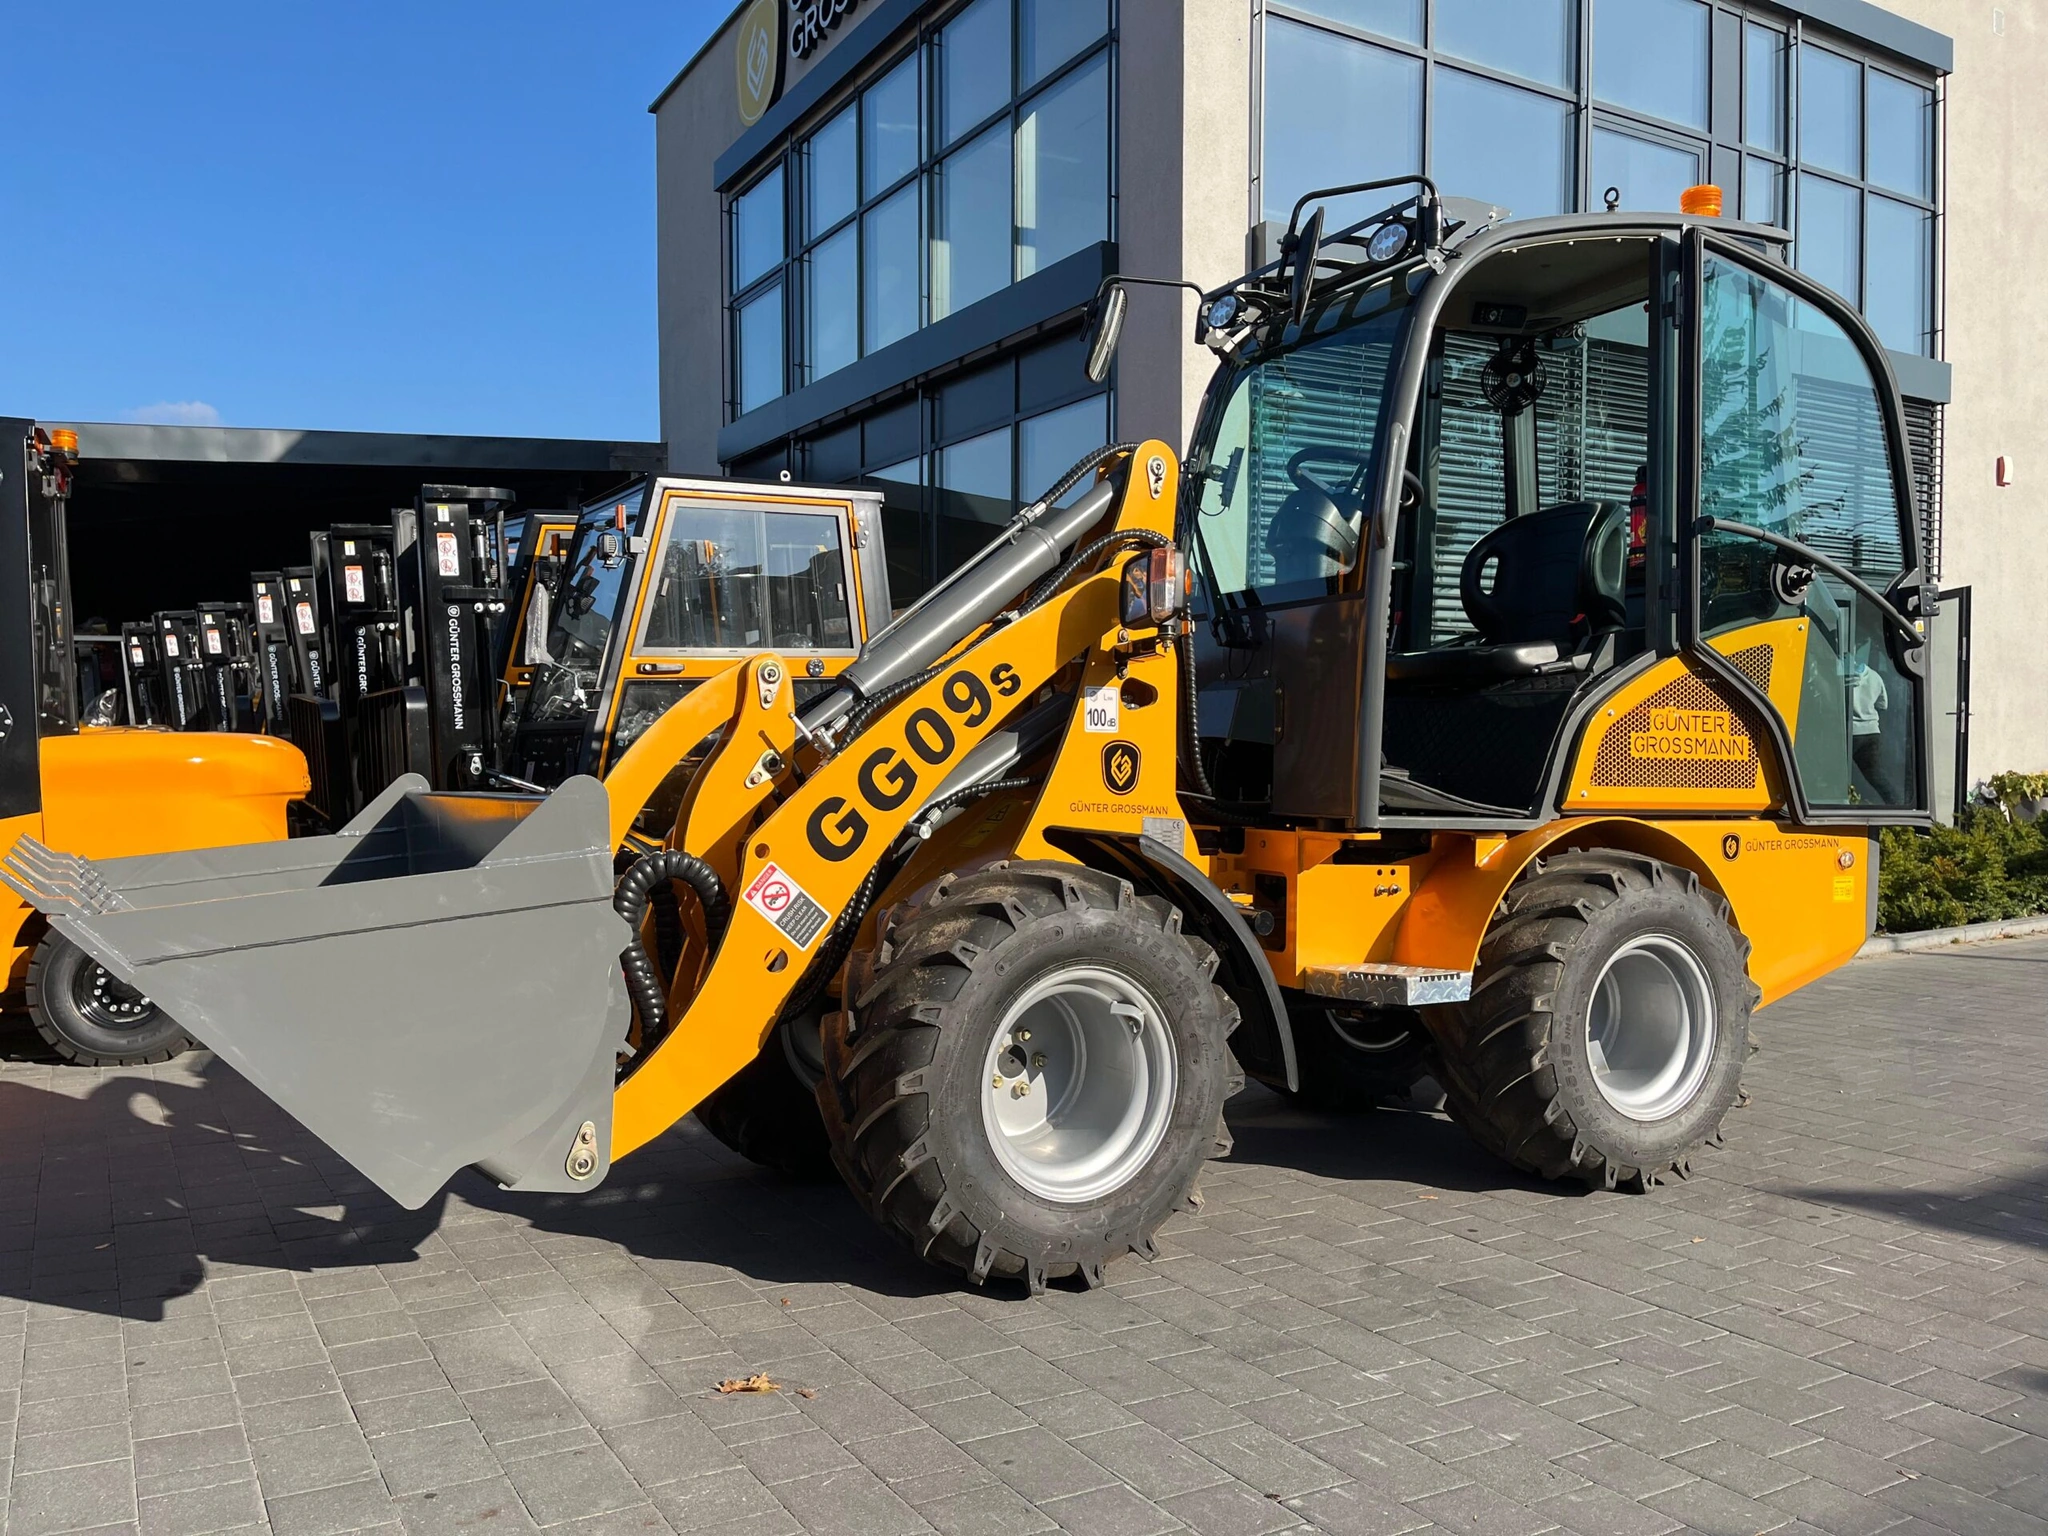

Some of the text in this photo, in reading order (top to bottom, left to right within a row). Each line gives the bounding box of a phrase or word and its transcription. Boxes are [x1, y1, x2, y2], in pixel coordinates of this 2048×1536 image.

[269, 652, 279, 680] GÜNTER
[356, 636, 367, 673] GÜNTER
[310, 660, 321, 692] GÜNTER
[448, 618, 464, 730] GÜNTER GROSSMANN
[1087, 708, 1107, 727] 100
[1653, 709, 1725, 733] GÜNTER
[1633, 735, 1744, 756] GROSSMANN
[1069, 800, 1169, 815] GÜNTER GROSSMANN
[1745, 838, 1840, 852] GÜNTER GROSSMANN
[779, 897, 805, 926] CRUSH RISK
[794, 906, 806, 920] CLEAR
